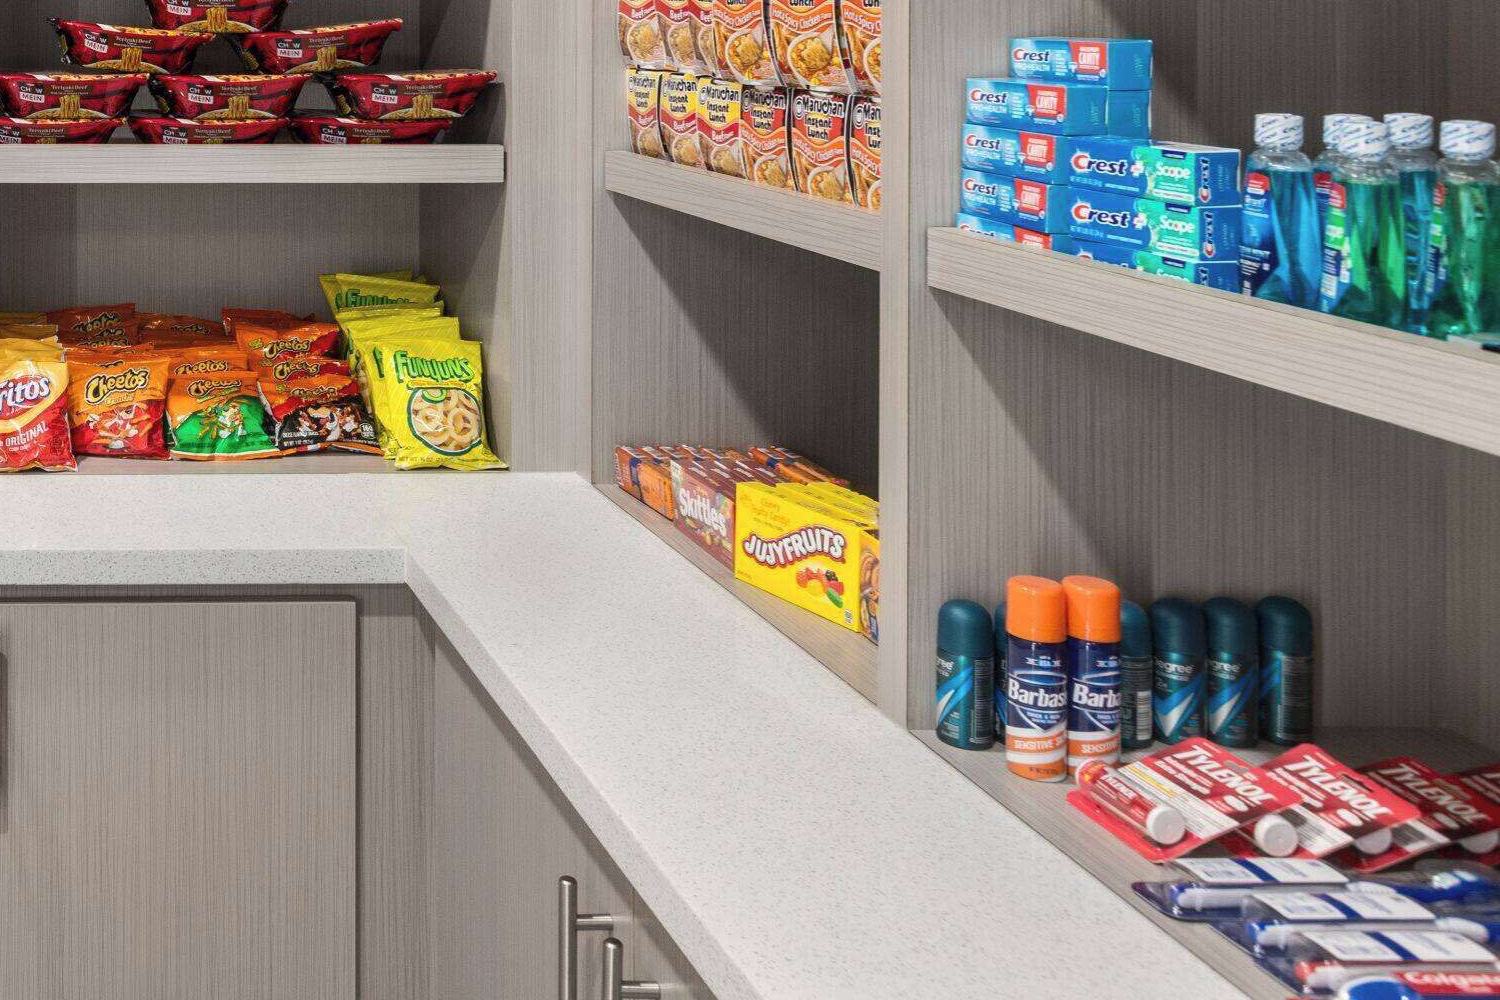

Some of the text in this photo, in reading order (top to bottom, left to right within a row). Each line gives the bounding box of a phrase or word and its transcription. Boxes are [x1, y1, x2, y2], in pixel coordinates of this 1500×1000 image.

[168, 5, 190, 15] MEIN
[1013, 48, 1049, 62] Crest
[802, 96, 844, 117] Maruchan
[969, 89, 1007, 104] Crest
[807, 127, 828, 140] Lunch
[965, 134, 1000, 150] Crest
[1071, 153, 1127, 175] Crest
[1155, 163, 1191, 180] Scope
[963, 179, 997, 195] Crest
[1071, 202, 1129, 228] Crest
[1160, 215, 1195, 234] Scope
[85, 368, 150, 405] Cheetos
[5, 421, 48, 447] ORIGINAL
[679, 486, 727, 536] Skittles
[743, 527, 846, 566] JUJYFRUITS
[1008, 679, 1067, 709] Barbas
[1172, 744, 1277, 803] TYLENOL
[1285, 754, 1393, 817] TYLENOL
[1379, 763, 1490, 824] TYLENOL
